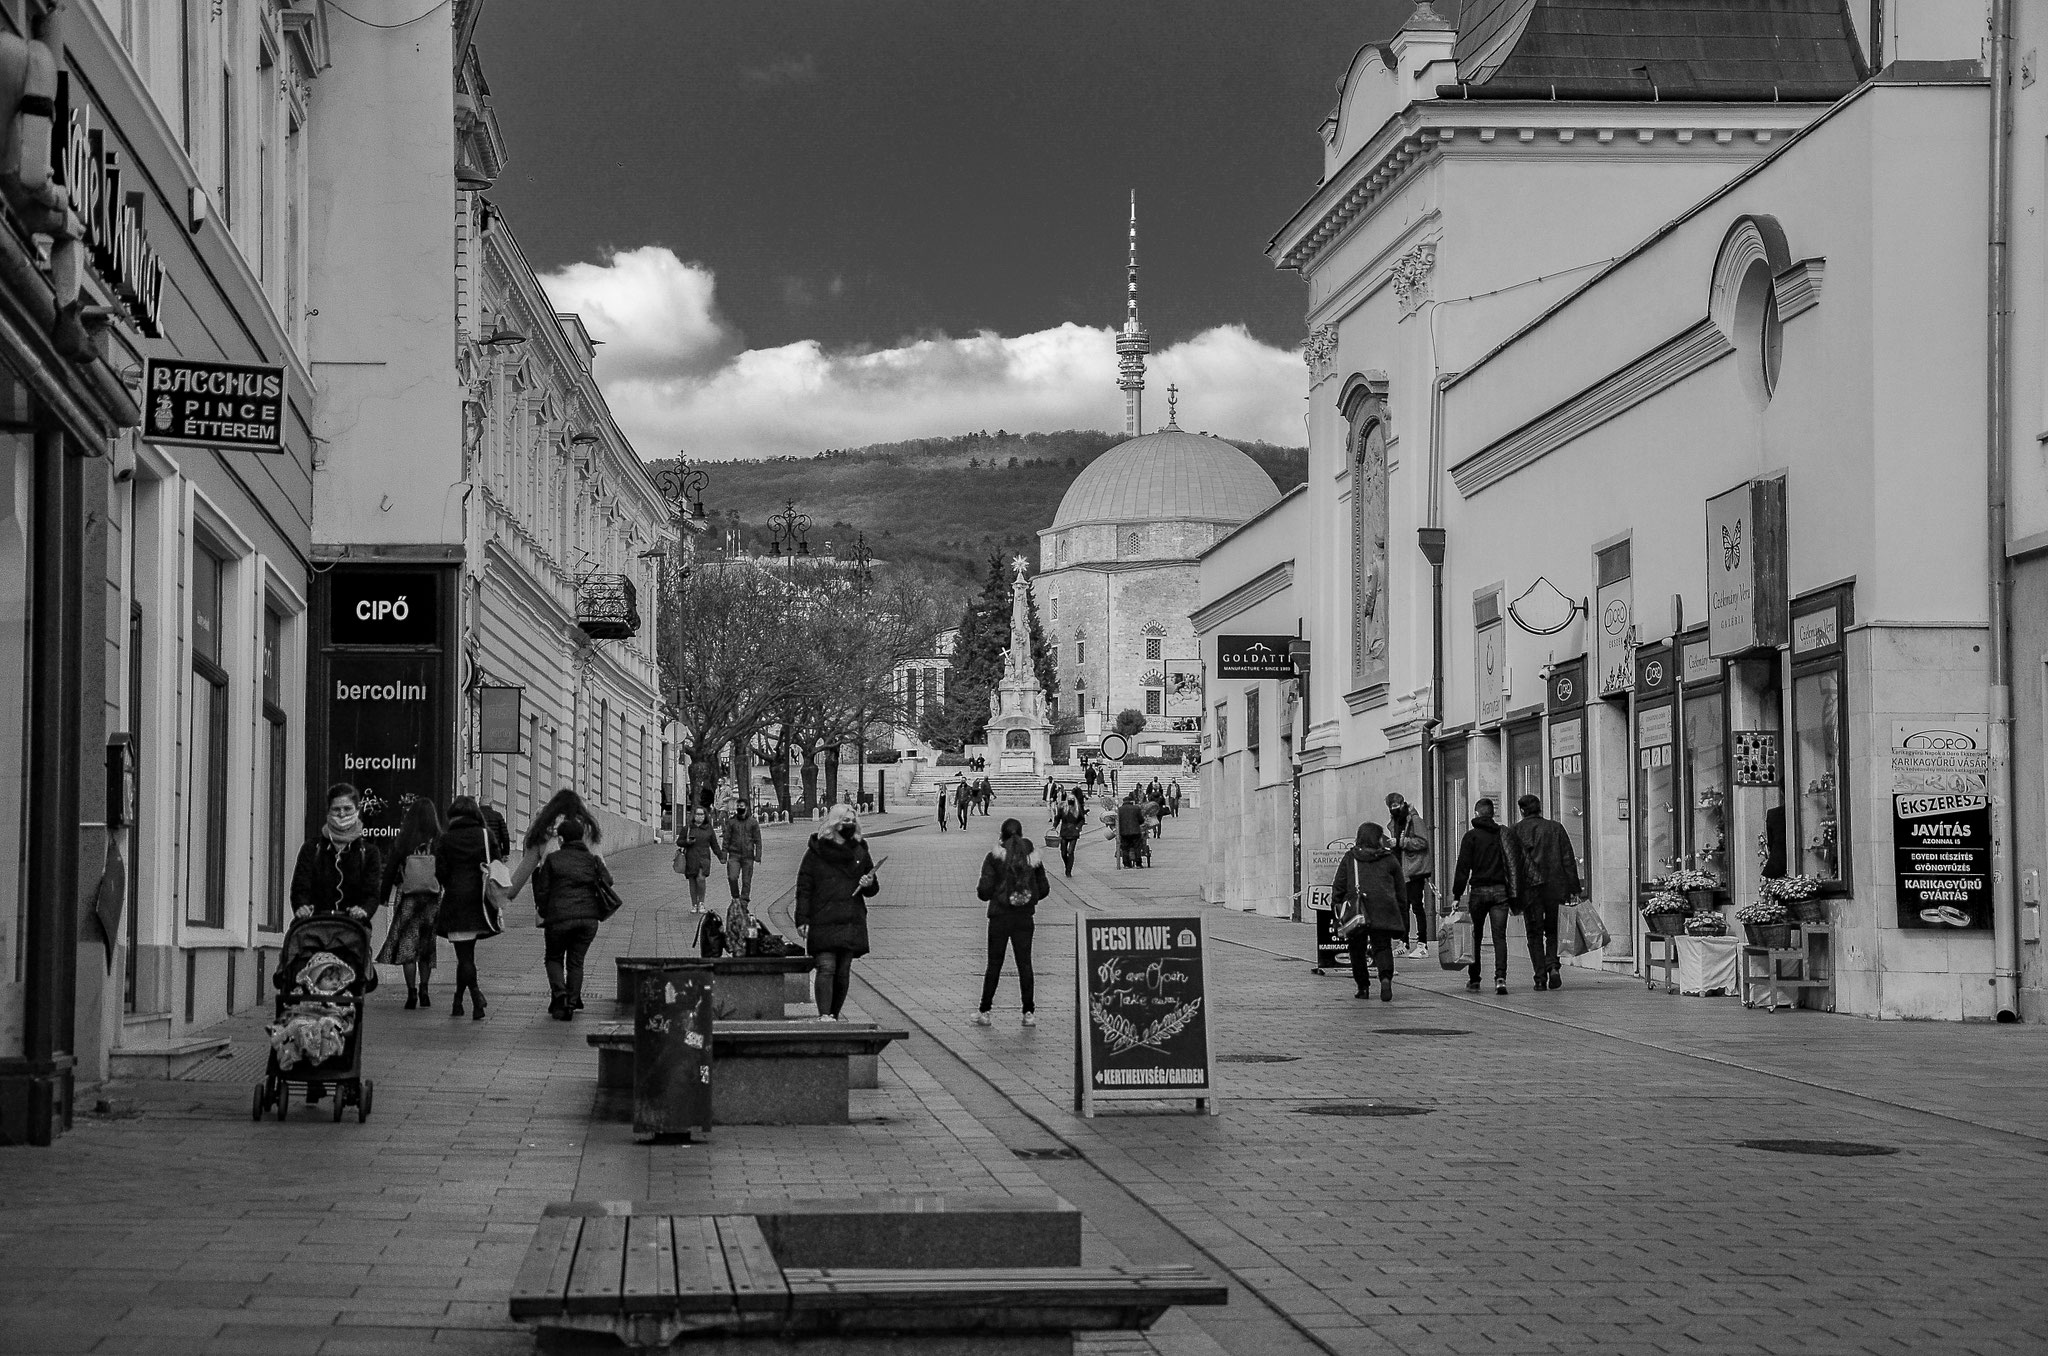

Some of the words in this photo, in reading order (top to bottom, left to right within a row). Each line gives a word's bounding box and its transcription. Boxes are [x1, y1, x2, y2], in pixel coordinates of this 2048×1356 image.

[152, 367, 280, 398] BACCHUS
[185, 400, 276, 420] PINCE
[184, 416, 275, 440] ÉTTEREM
[356, 596, 409, 621] CIPŐ
[1222, 654, 1291, 663] GOLDATTI
[336, 680, 427, 700] bercolini
[1913, 736, 1968, 749] DORO
[344, 754, 416, 770] bercolini
[1892, 757, 1955, 767] KARIKAGYŰRŰ
[1957, 757, 1987, 768] VÁSÁR
[359, 825, 401, 837] ercolin
[1911, 821, 1972, 837] JAVÍTÁS
[1940, 852, 1973, 861] KÉSZÍTÉS
[1905, 878, 1982, 890] KARIKAGYŰRŰ
[1920, 889, 1968, 901] GYÁRTÁS
[1146, 957, 1189, 996] Open
[1114, 986, 1147, 1007] Take
[1104, 1066, 1204, 1085] KERTHELYISÉG/GARDEN
